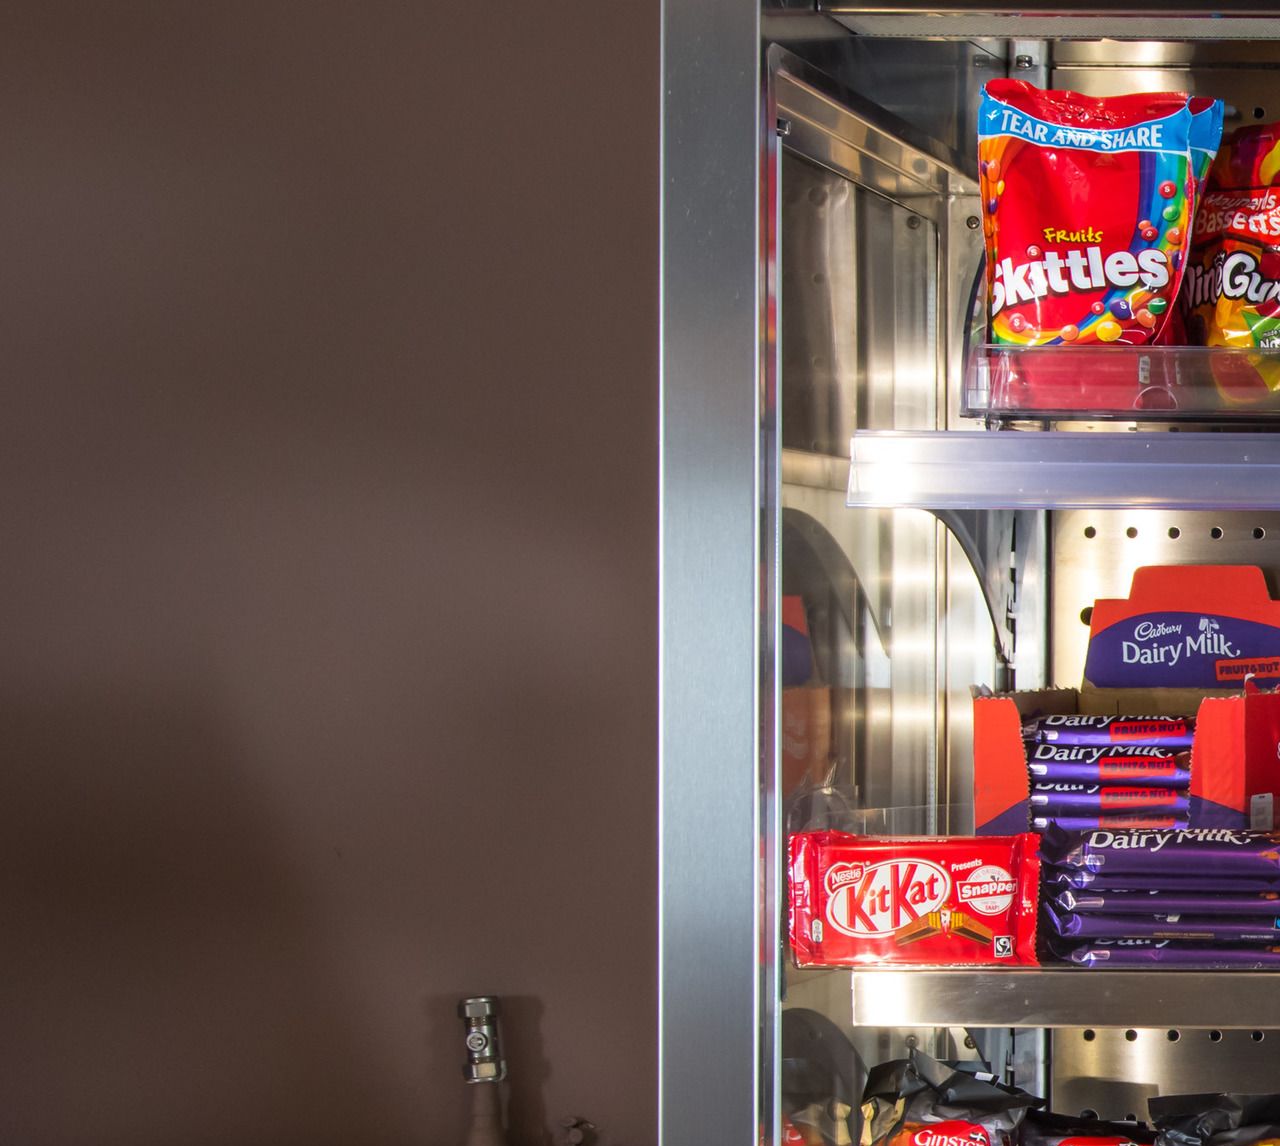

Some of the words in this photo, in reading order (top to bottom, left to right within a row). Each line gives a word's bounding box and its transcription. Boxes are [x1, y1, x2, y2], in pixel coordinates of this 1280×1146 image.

[1001, 110, 1046, 142] TEAR
[1052, 129, 1095, 147] AND
[1101, 125, 1163, 148] SHARE
[1122, 641, 1183, 666] Dairy
[951, 859, 982, 872] Presents
[961, 879, 1017, 898] Snapper
